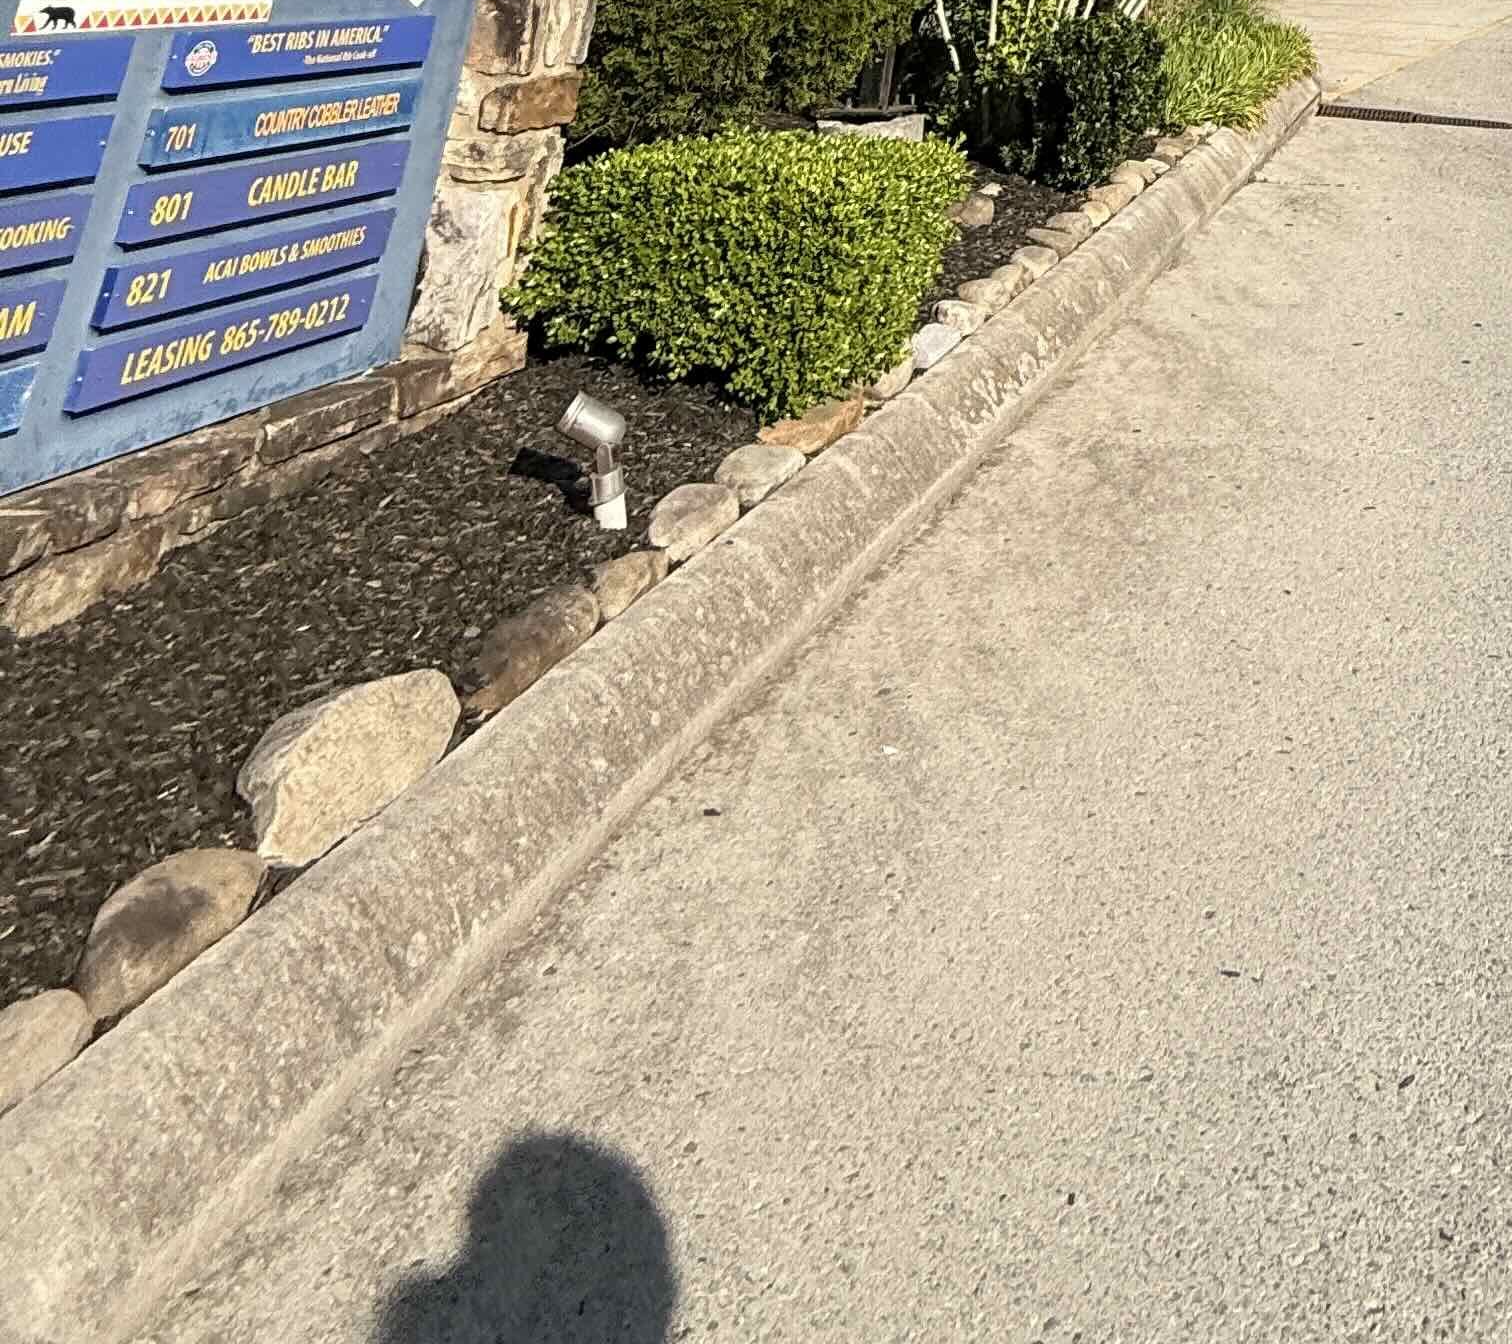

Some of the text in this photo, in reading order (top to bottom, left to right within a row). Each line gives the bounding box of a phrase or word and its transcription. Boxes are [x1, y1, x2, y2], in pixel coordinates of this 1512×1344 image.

[287, 30, 314, 51] RIBS
[315, 28, 331, 49] IN
[164, 92, 401, 152] 701 COUNTRY COBBLER LEATHER
[150, 160, 359, 226] 801 CANDLE BAR
[126, 225, 368, 308] 821 ACAI BOWLS & SMOOTHIES
[120, 294, 350, 385] LEASING 865-789-0212
